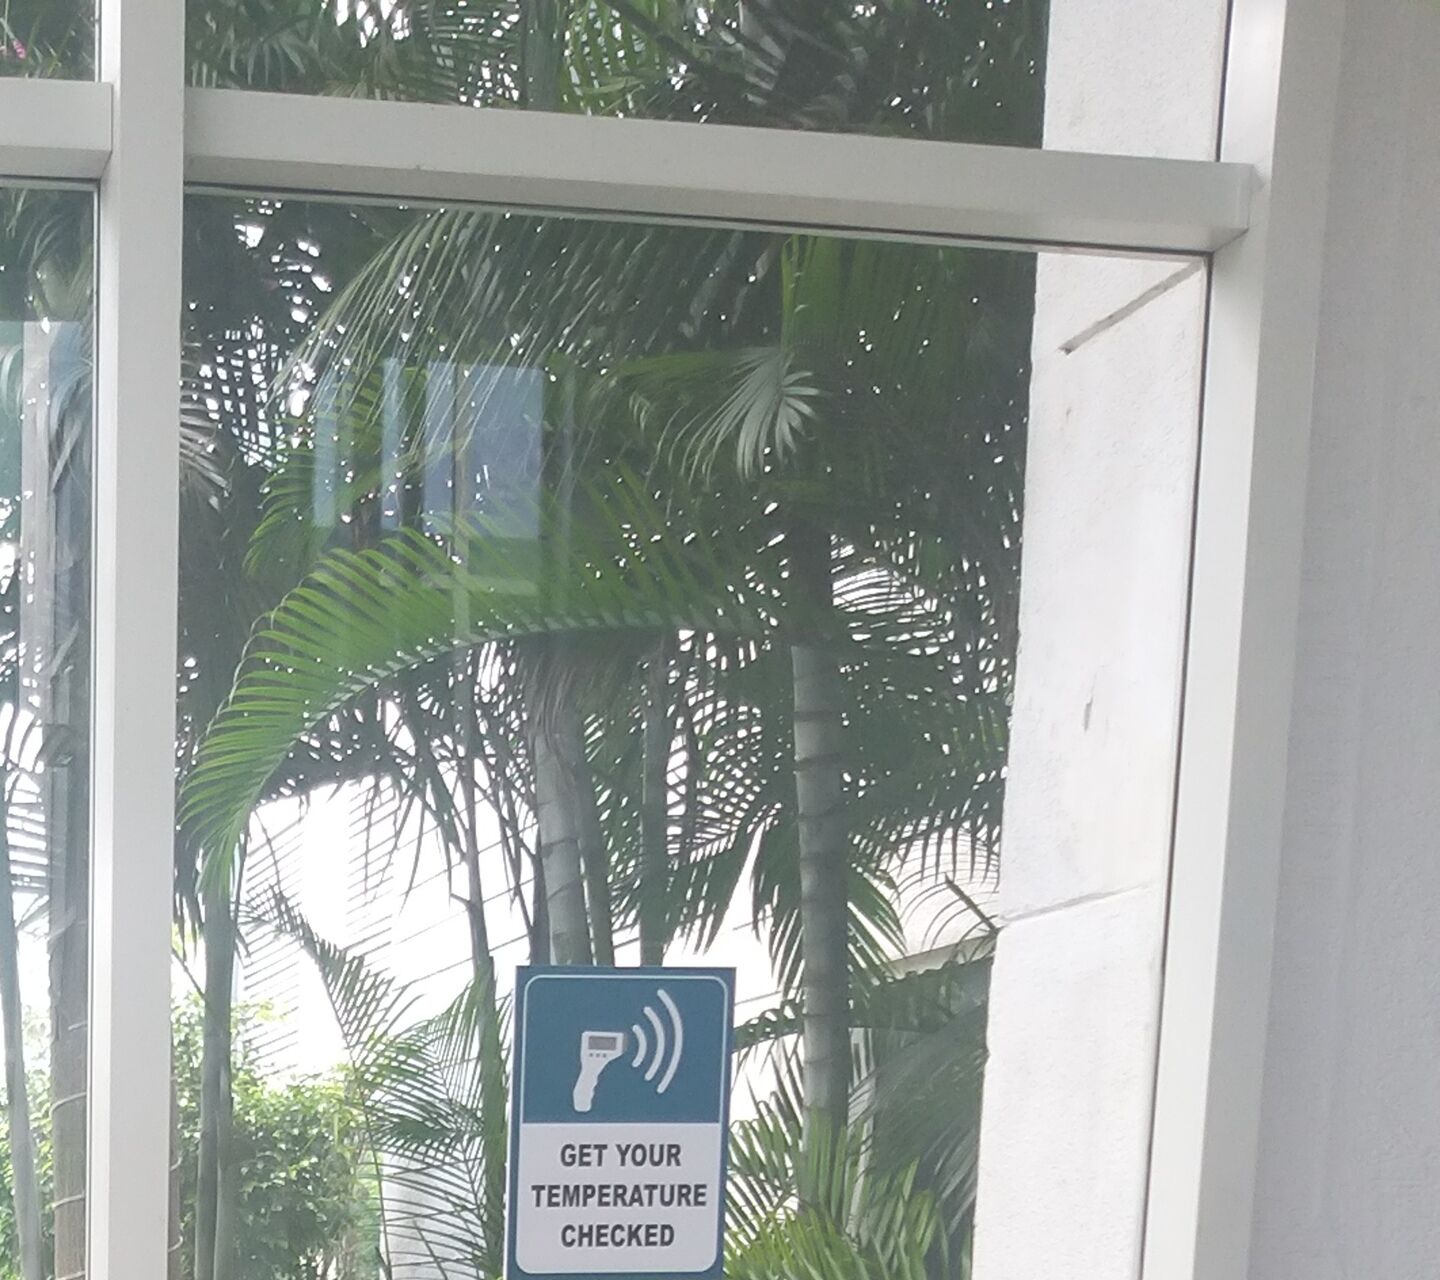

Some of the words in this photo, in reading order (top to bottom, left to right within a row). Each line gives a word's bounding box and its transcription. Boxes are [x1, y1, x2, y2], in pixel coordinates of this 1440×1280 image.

[560, 1143, 607, 1167] GET
[616, 1143, 681, 1167] YOUR
[531, 1184, 708, 1208] TEMPERATURE
[560, 1224, 675, 1248] CHECKED
